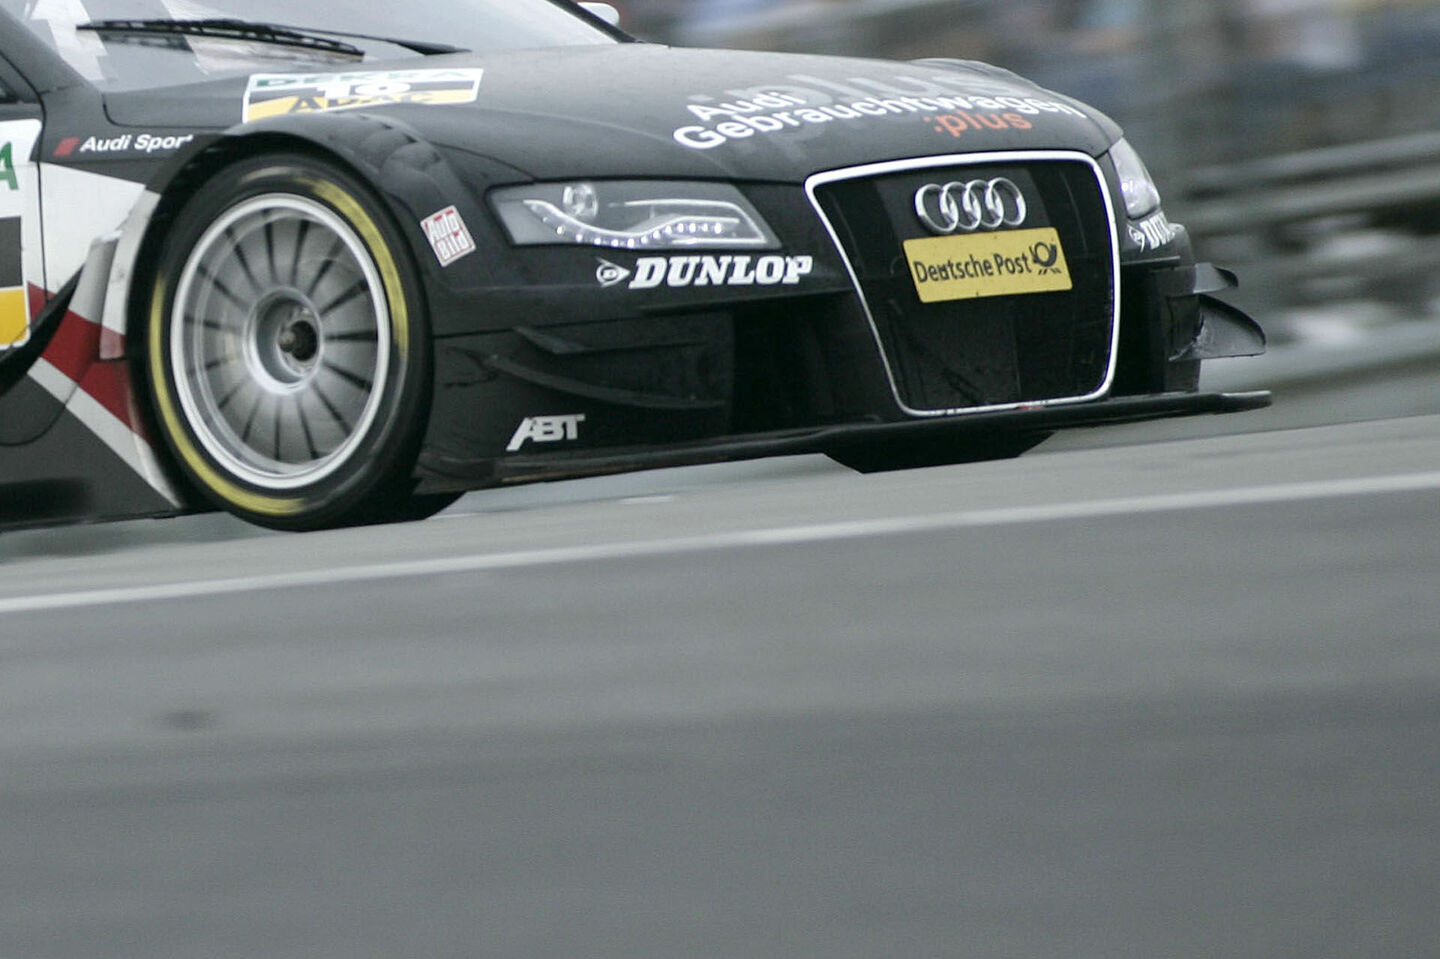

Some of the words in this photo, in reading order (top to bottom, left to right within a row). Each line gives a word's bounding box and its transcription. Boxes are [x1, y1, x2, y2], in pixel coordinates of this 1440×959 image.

[672, 96, 1087, 150] Gebrauchtwagen
[686, 91, 807, 122] Audi
[79, 134, 132, 152] Audi
[628, 255, 813, 289] DUNLOP
[913, 252, 995, 284] Deutsche
[995, 252, 1032, 274] Post
[505, 413, 586, 453] ABT
